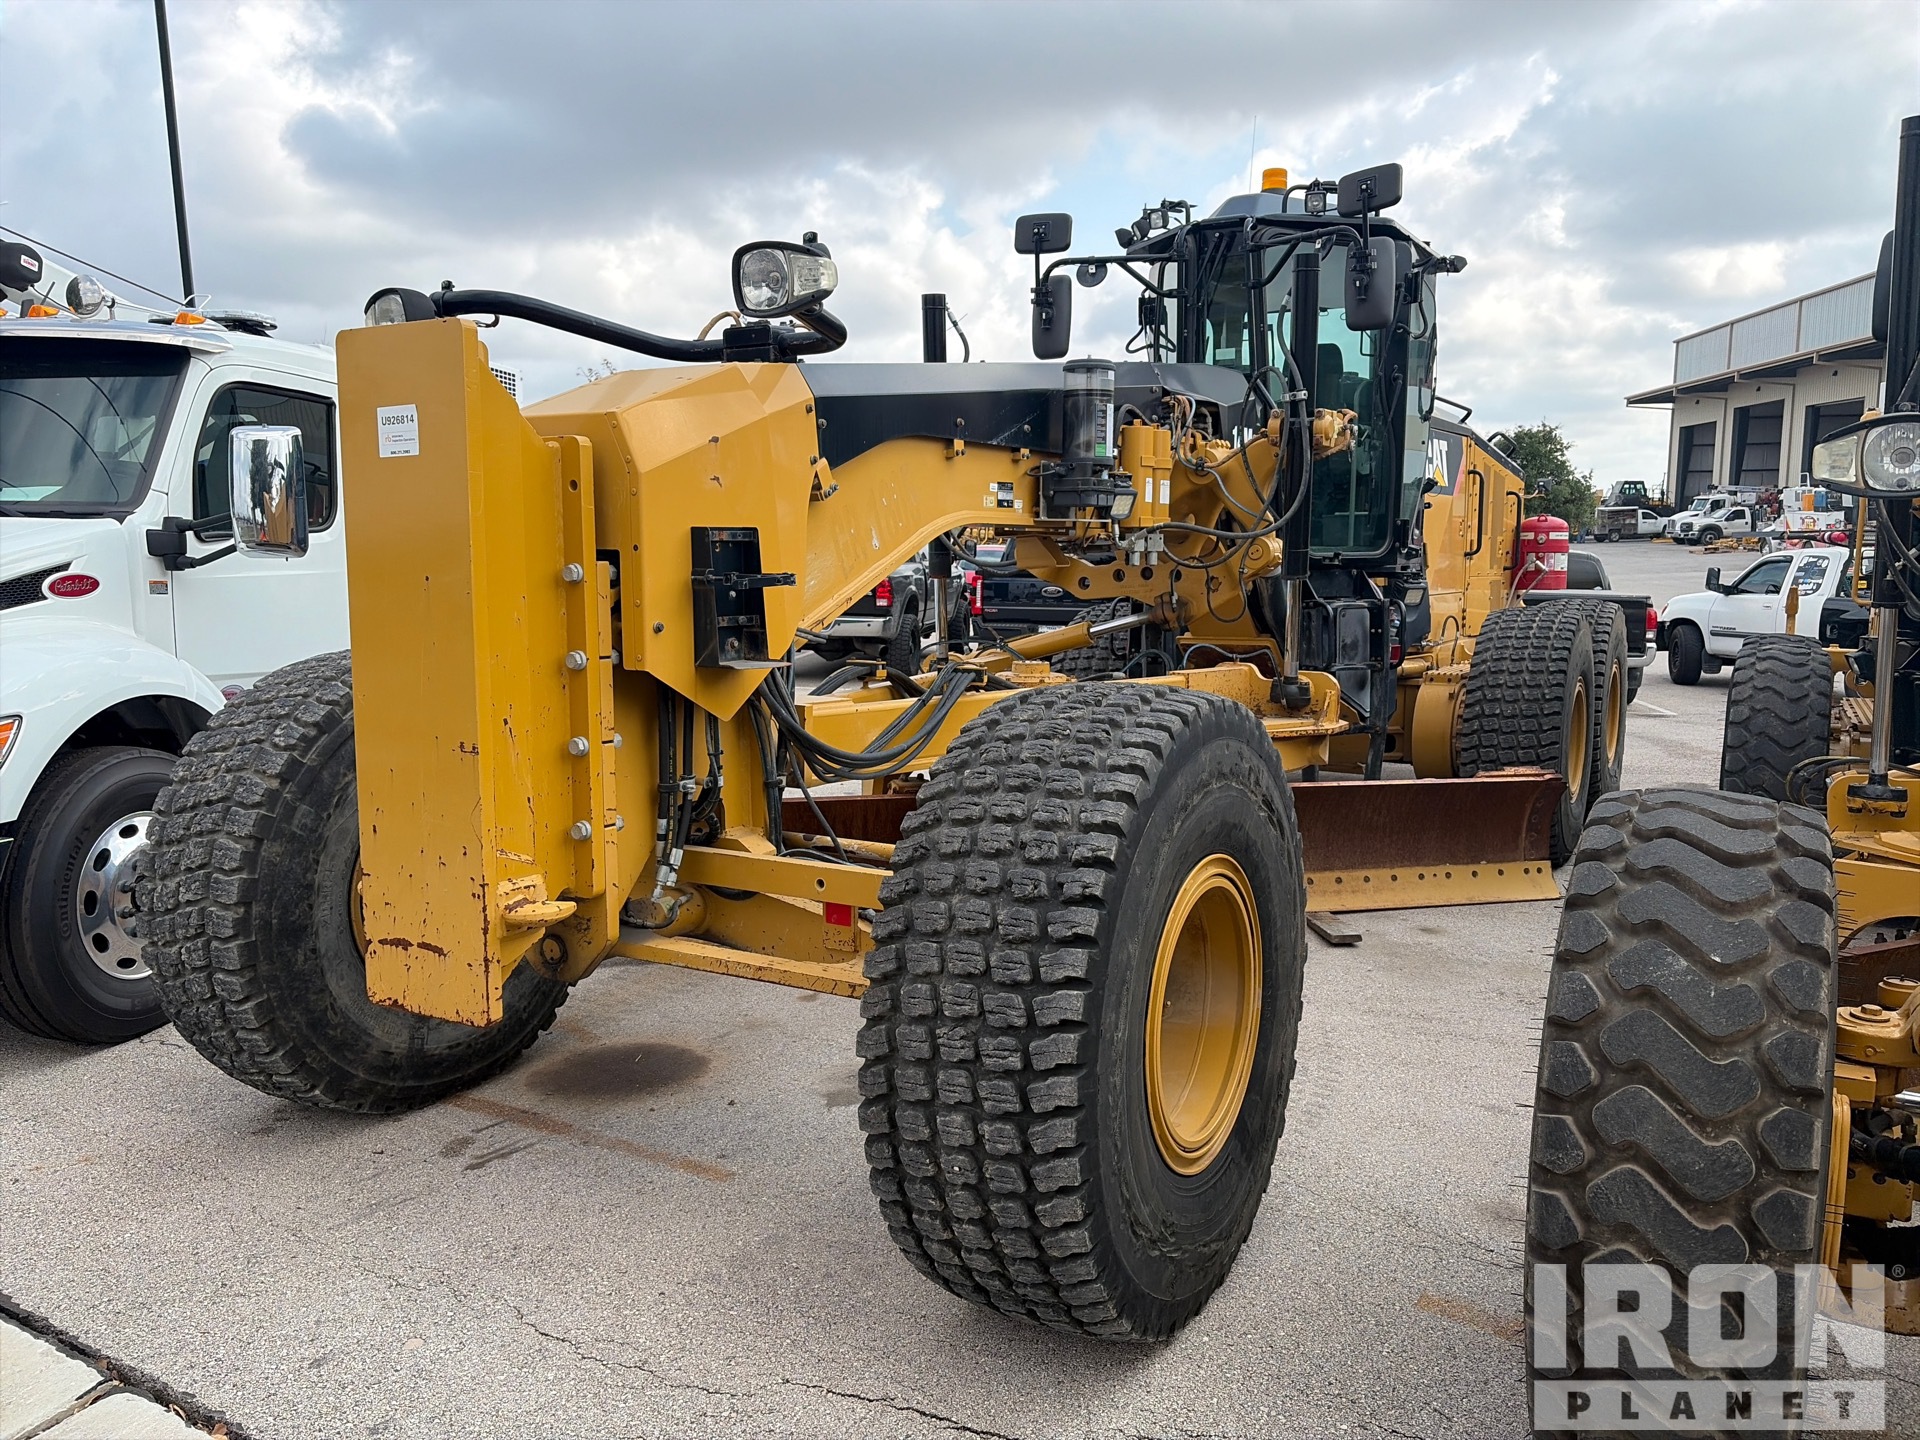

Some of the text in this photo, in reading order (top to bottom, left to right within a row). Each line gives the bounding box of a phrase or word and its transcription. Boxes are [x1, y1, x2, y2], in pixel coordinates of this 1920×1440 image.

[381, 414, 415, 426] U926814
[1425, 438, 1449, 487] CAT
[54, 578, 95, 593] Peterbilt
